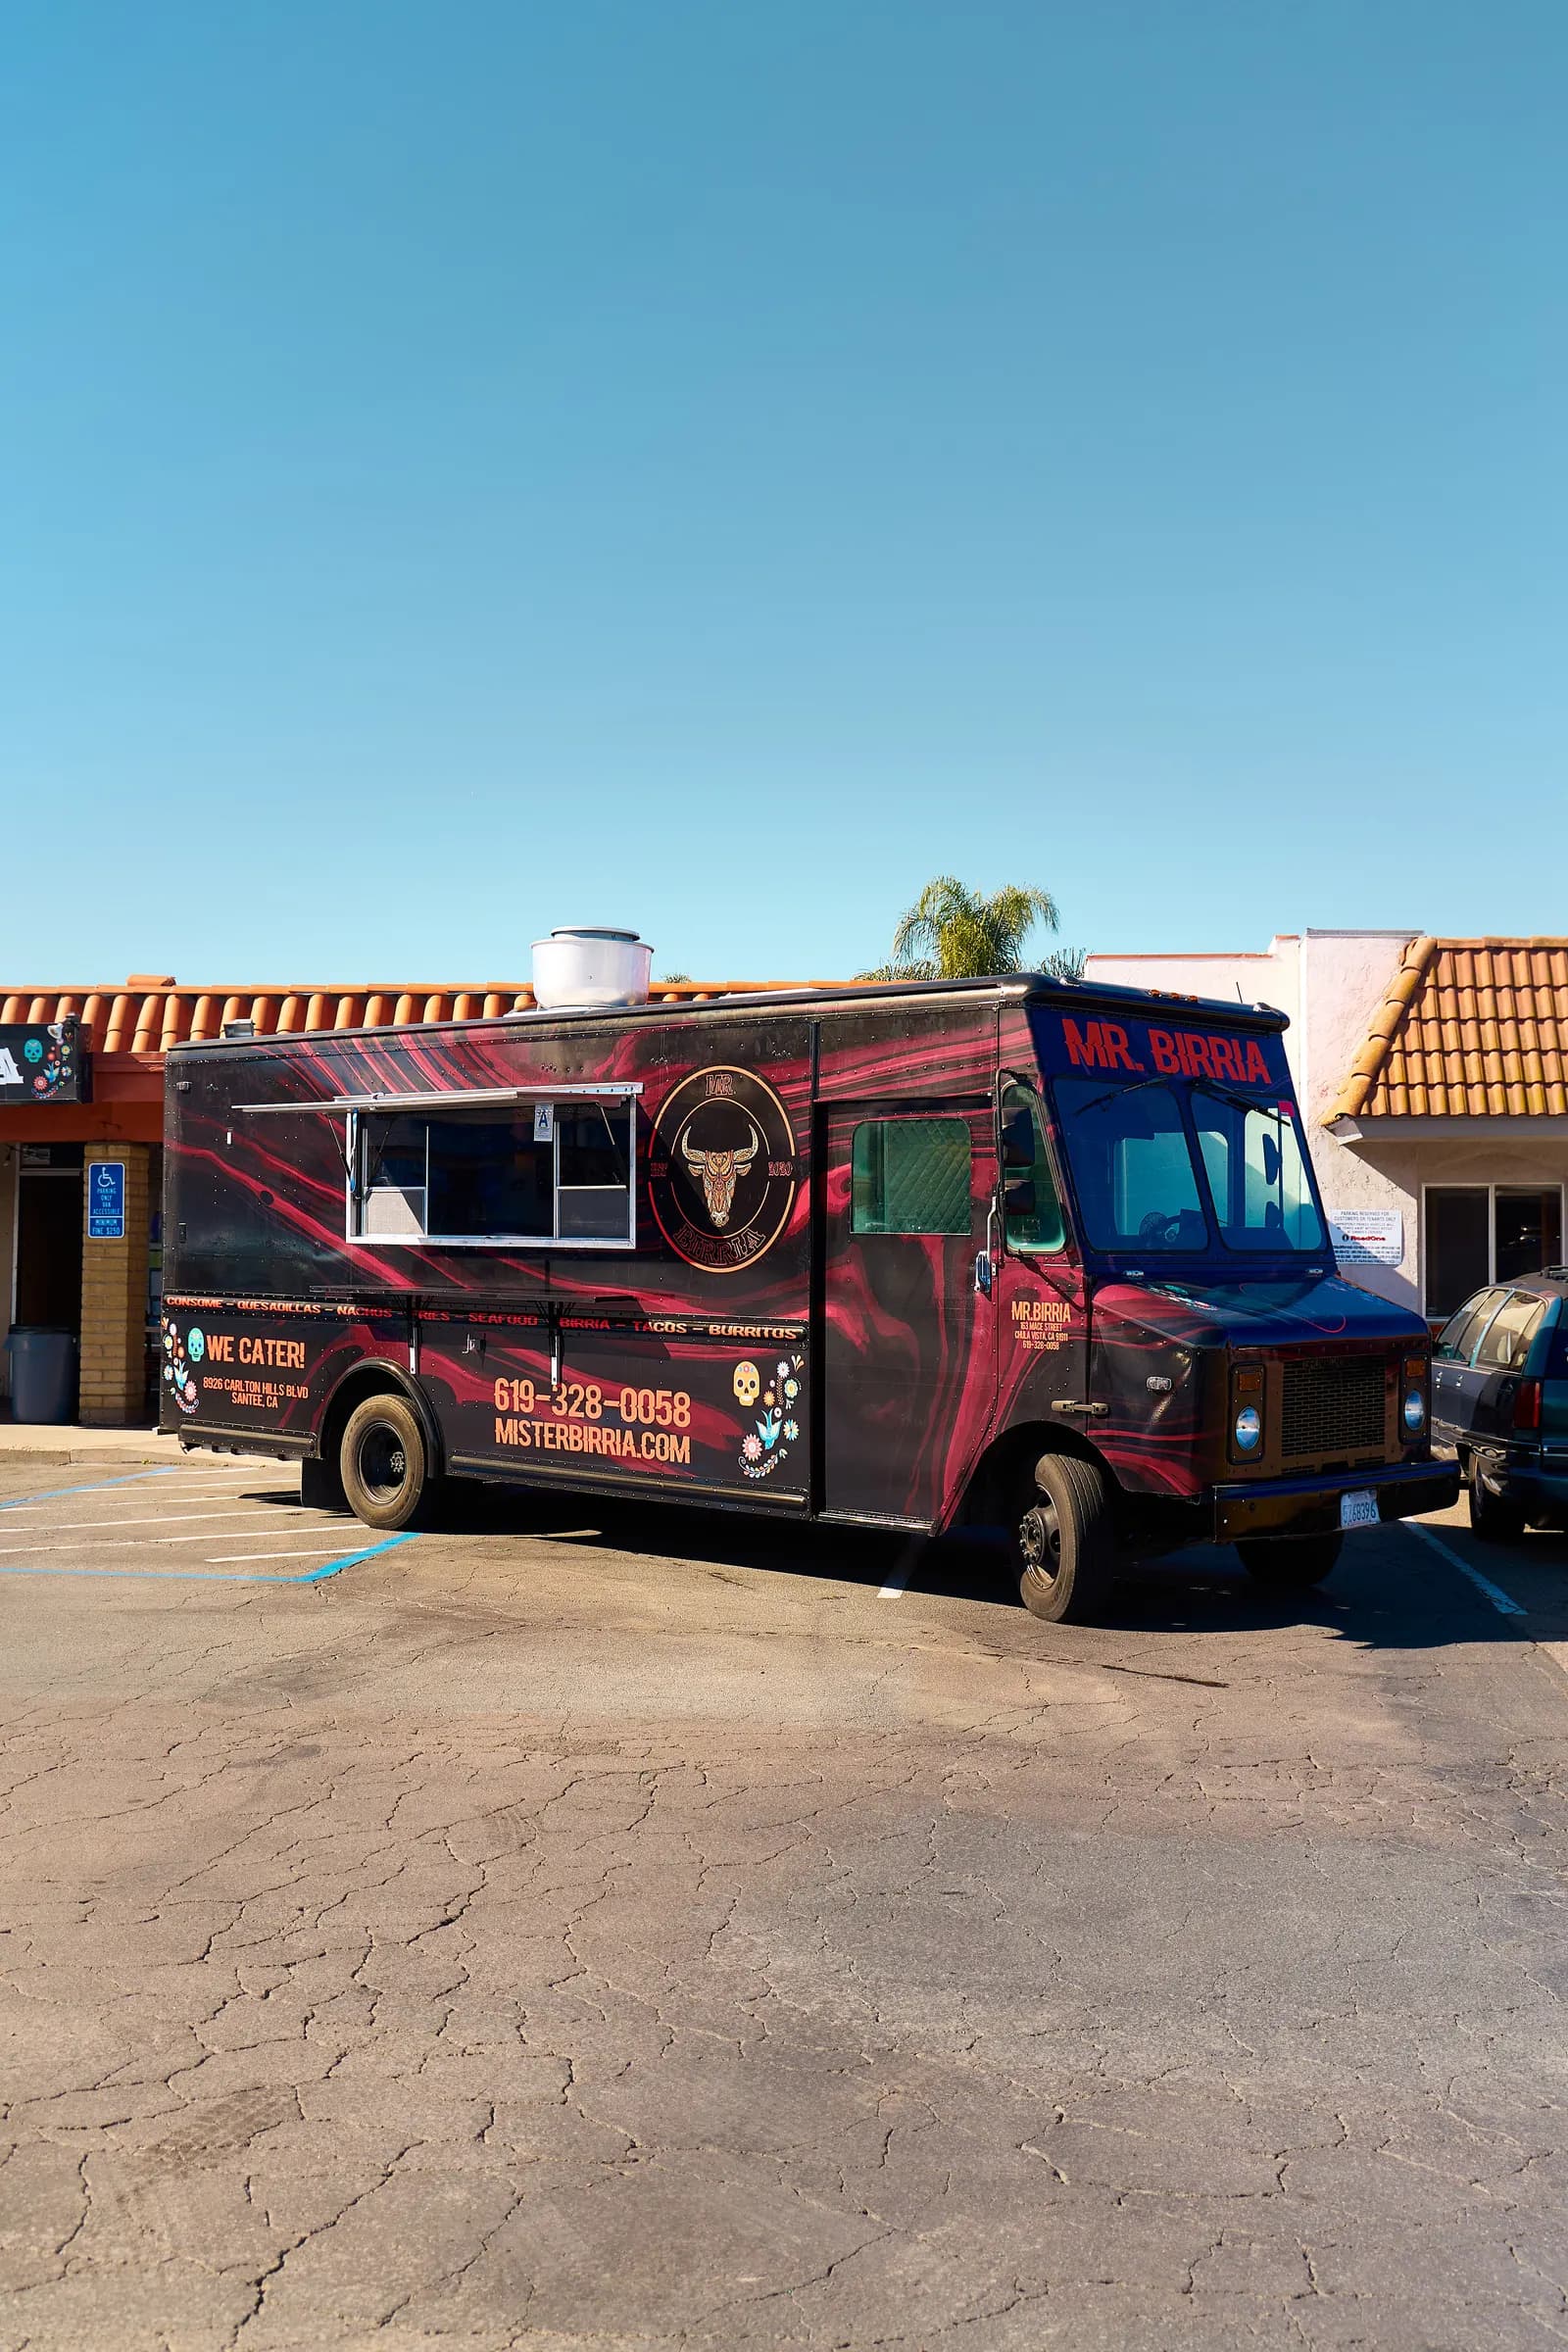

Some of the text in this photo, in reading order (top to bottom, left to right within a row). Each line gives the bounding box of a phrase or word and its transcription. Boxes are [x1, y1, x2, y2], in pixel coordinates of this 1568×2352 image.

[1061, 1018, 1272, 1084] MR. BIRRIA
[767, 1161, 794, 1177] 2020
[672, 1227, 766, 1266] BIRRIA
[166, 1296, 798, 1340] CONSOME QUESADILLAS NACHOS RIES SEAFOOD BIRRIA TACOS BURRITOS
[1044, 1323, 1063, 1332] STREET
[1014, 1330, 1031, 1340] CHULA
[1048, 1332, 1055, 1341] CA
[1022, 1340, 1060, 1350] 619-328-0058
[206, 1335, 306, 1369] WE CATER!
[203, 1377, 309, 1399] 8926 CARLTON HILLS BLVD
[231, 1392, 278, 1408] SANTEE, CA
[494, 1377, 691, 1428] 619-328-0058
[494, 1417, 691, 1464] MISTERBIRRIA.COM
